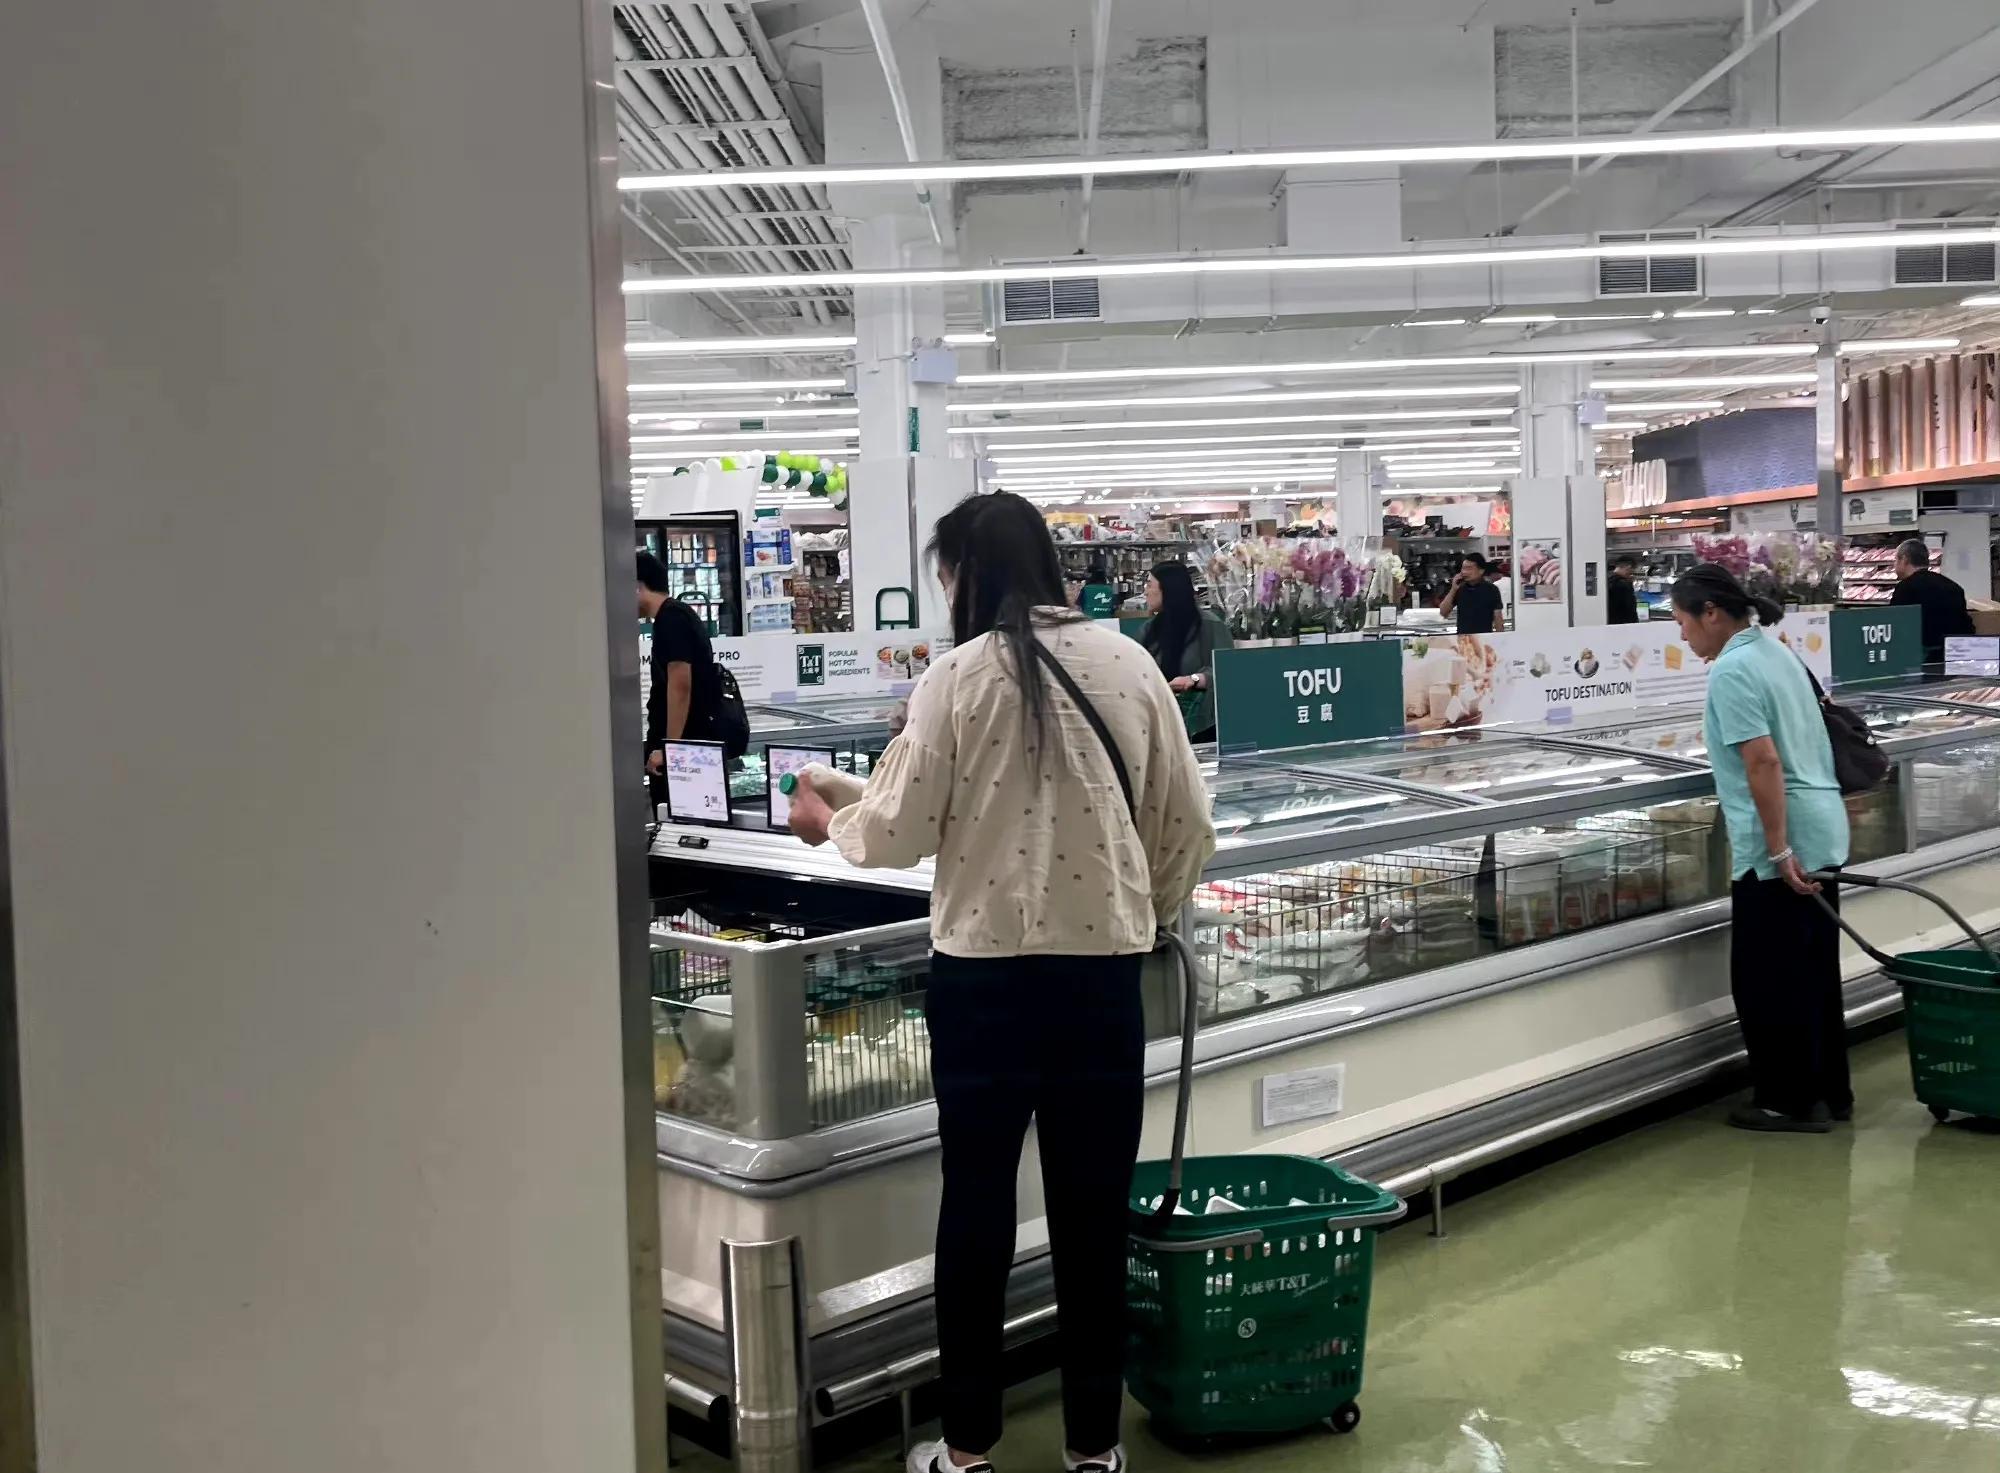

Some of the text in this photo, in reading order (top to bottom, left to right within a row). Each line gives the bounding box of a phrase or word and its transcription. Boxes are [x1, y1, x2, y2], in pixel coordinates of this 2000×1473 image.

[1862, 624, 1892, 644] TOFU
[718, 650, 740, 661] PRO
[828, 649, 858, 658] POPULAR
[828, 659, 843, 667] HOT
[828, 667, 870, 677] INGREDIENTS
[1284, 667, 1342, 698] TOFU
[1545, 686, 1571, 702] TOFU
[1573, 681, 1632, 699] DESTINATION
[1297, 703, 1333, 724] 豆腐
[1277, 1273, 1311, 1291] T&T
